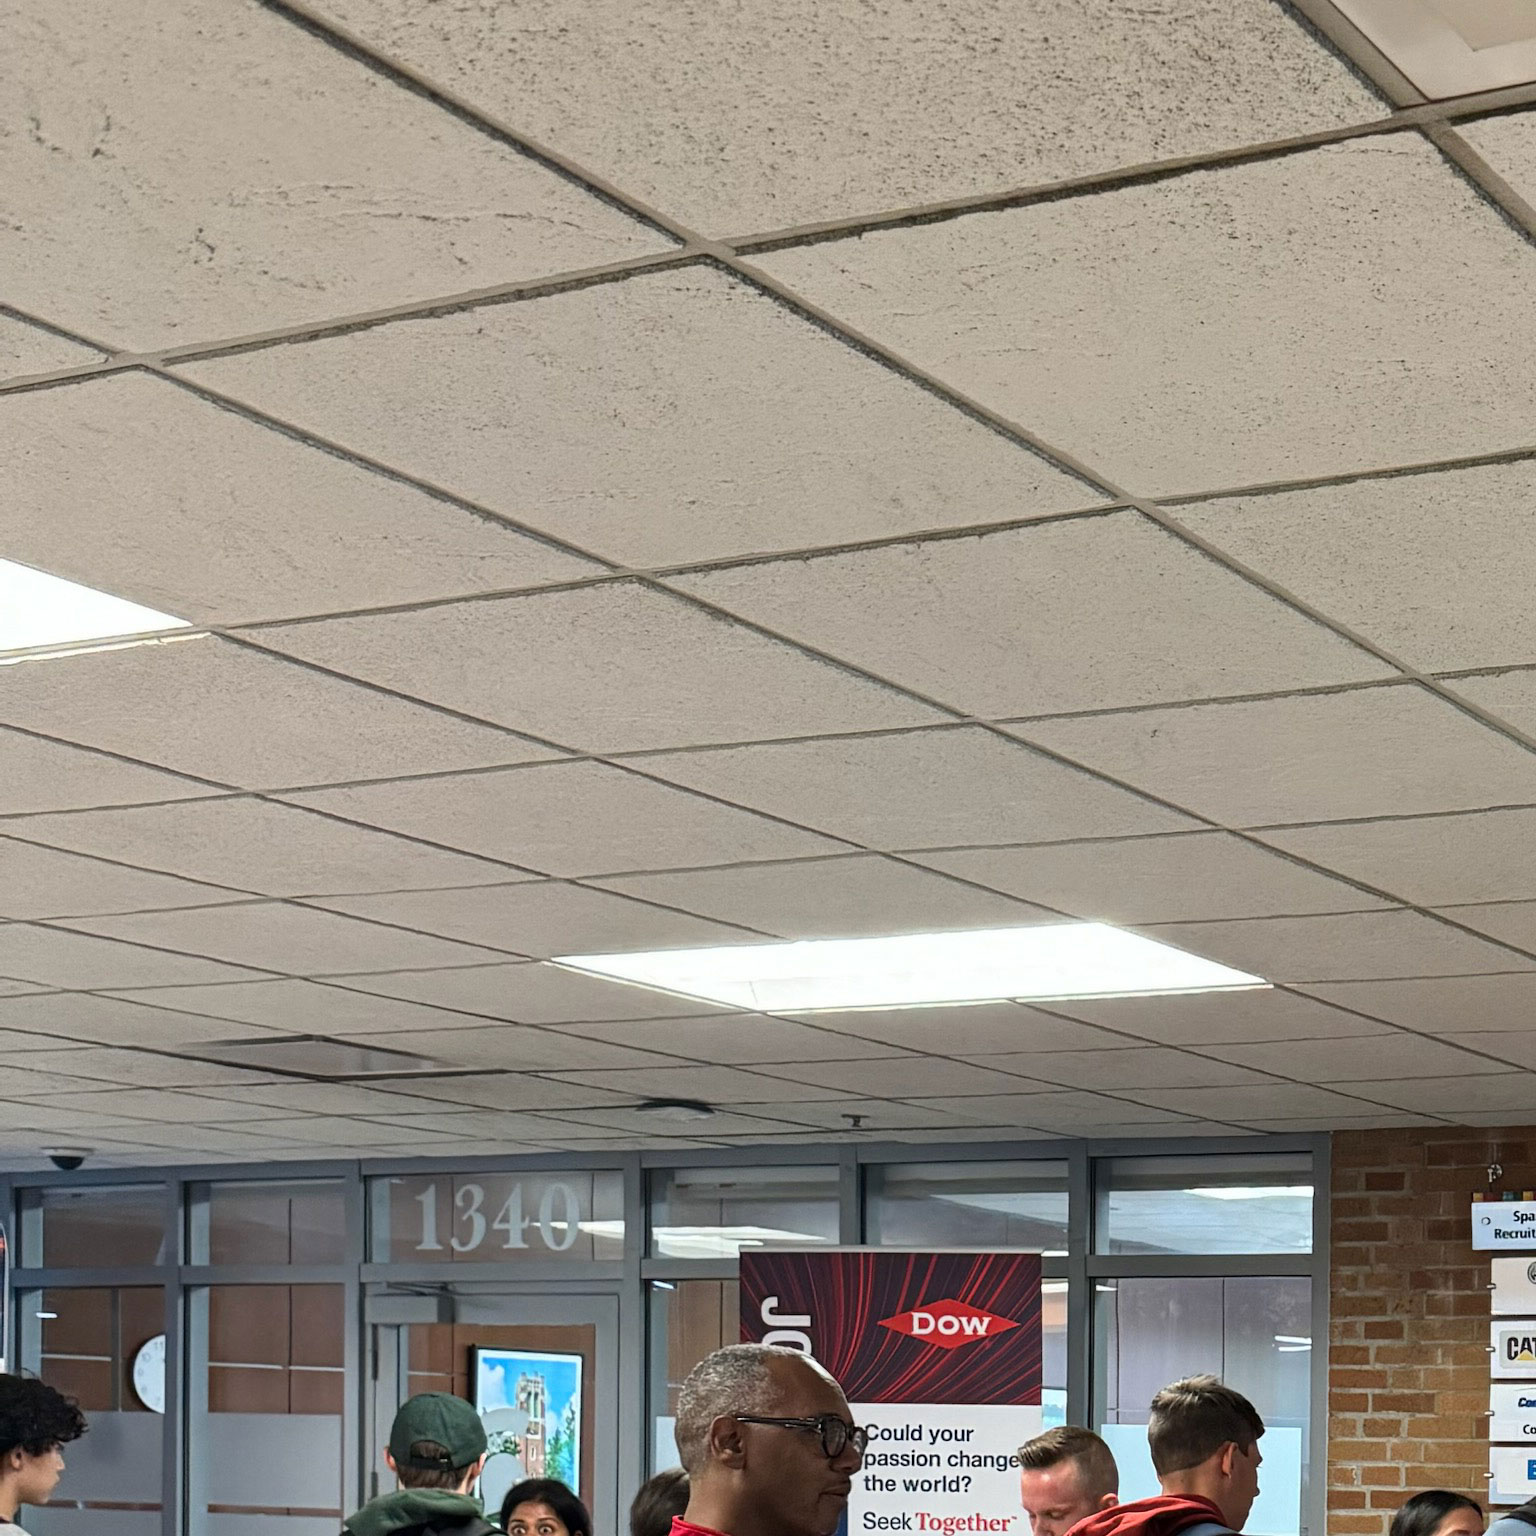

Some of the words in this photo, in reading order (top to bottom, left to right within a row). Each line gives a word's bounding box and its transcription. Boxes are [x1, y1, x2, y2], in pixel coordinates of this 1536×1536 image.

[415, 1182, 580, 1252] 1340
[864, 1424, 922, 1441] Could
[929, 1429, 974, 1445] your
[864, 1450, 941, 1470] passion
[947, 1451, 1020, 1472] change
[863, 1475, 896, 1491] the
[903, 1476, 972, 1492] world?
[863, 1512, 912, 1531] Seek
